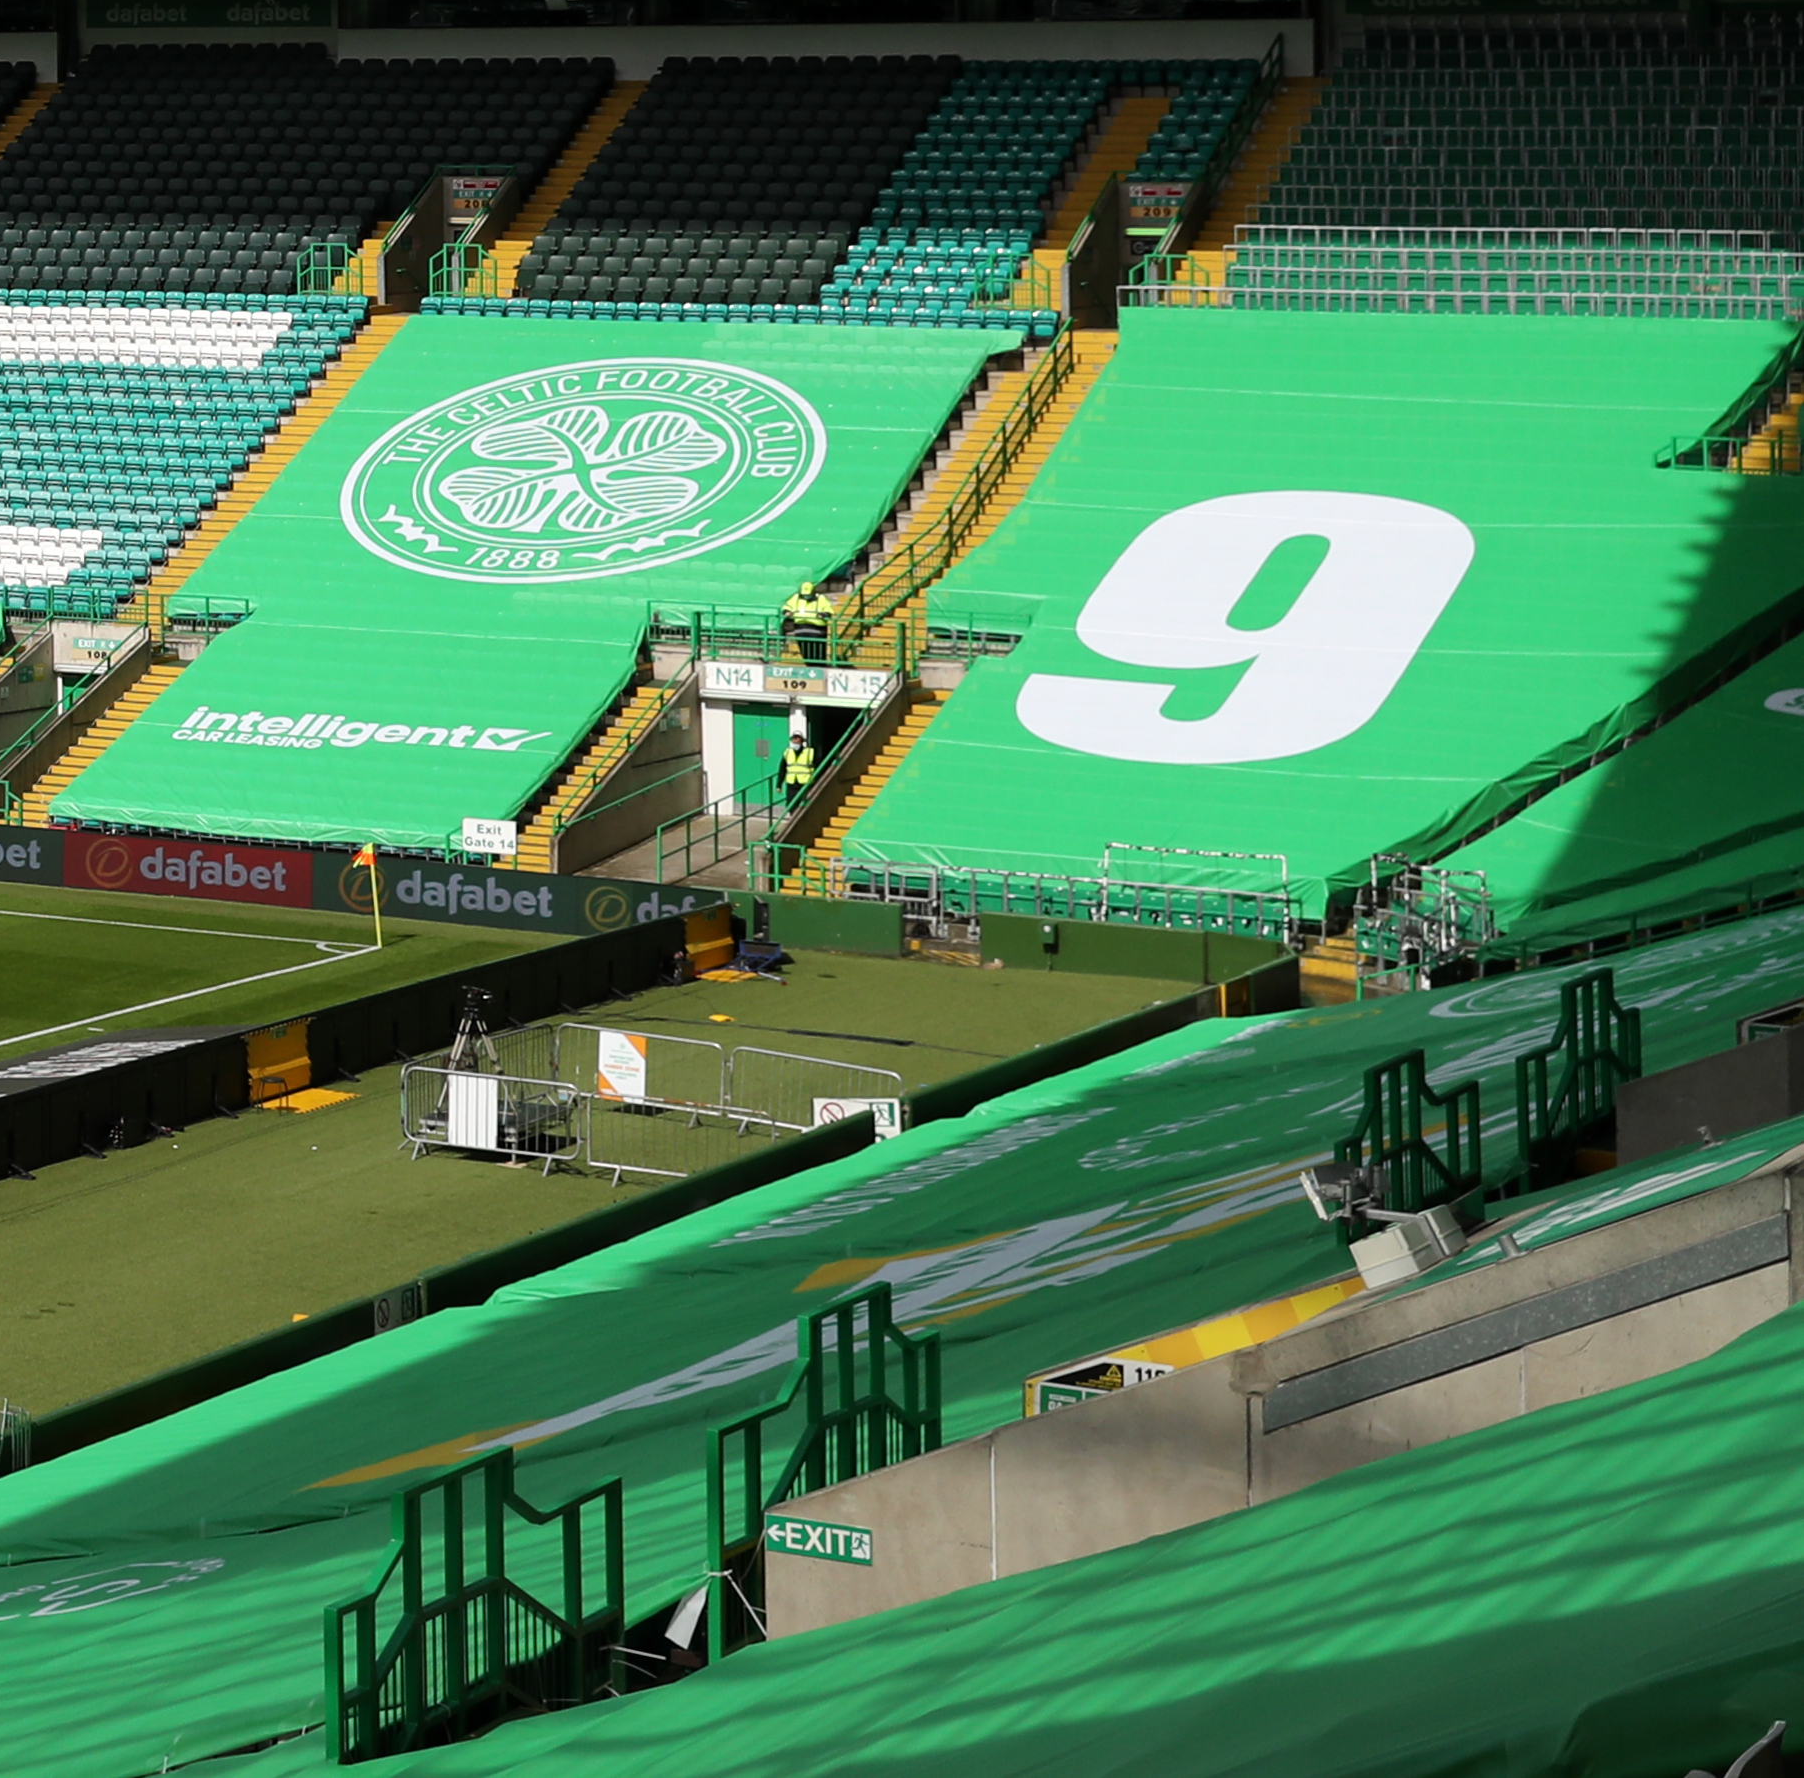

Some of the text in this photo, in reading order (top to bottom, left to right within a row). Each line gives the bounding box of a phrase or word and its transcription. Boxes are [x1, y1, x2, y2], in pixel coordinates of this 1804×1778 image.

[1143, 207, 1171, 218] 209
[382, 369, 797, 479] THE CELTIC FOOTBALL CLUB
[465, 546, 562, 570] 1888
[1015, 490, 1477, 764] 9
[715, 667, 753, 688] N14
[783, 679, 808, 690] 109
[172, 729, 324, 749] CAR LEASING
[180, 705, 476, 749] intelligent
[476, 823, 503, 836] Exit
[464, 836, 515, 850] Gate 14
[139, 846, 287, 893] dafabet
[396, 870, 553, 919] dafabet
[785, 1521, 852, 1557] EXIT
